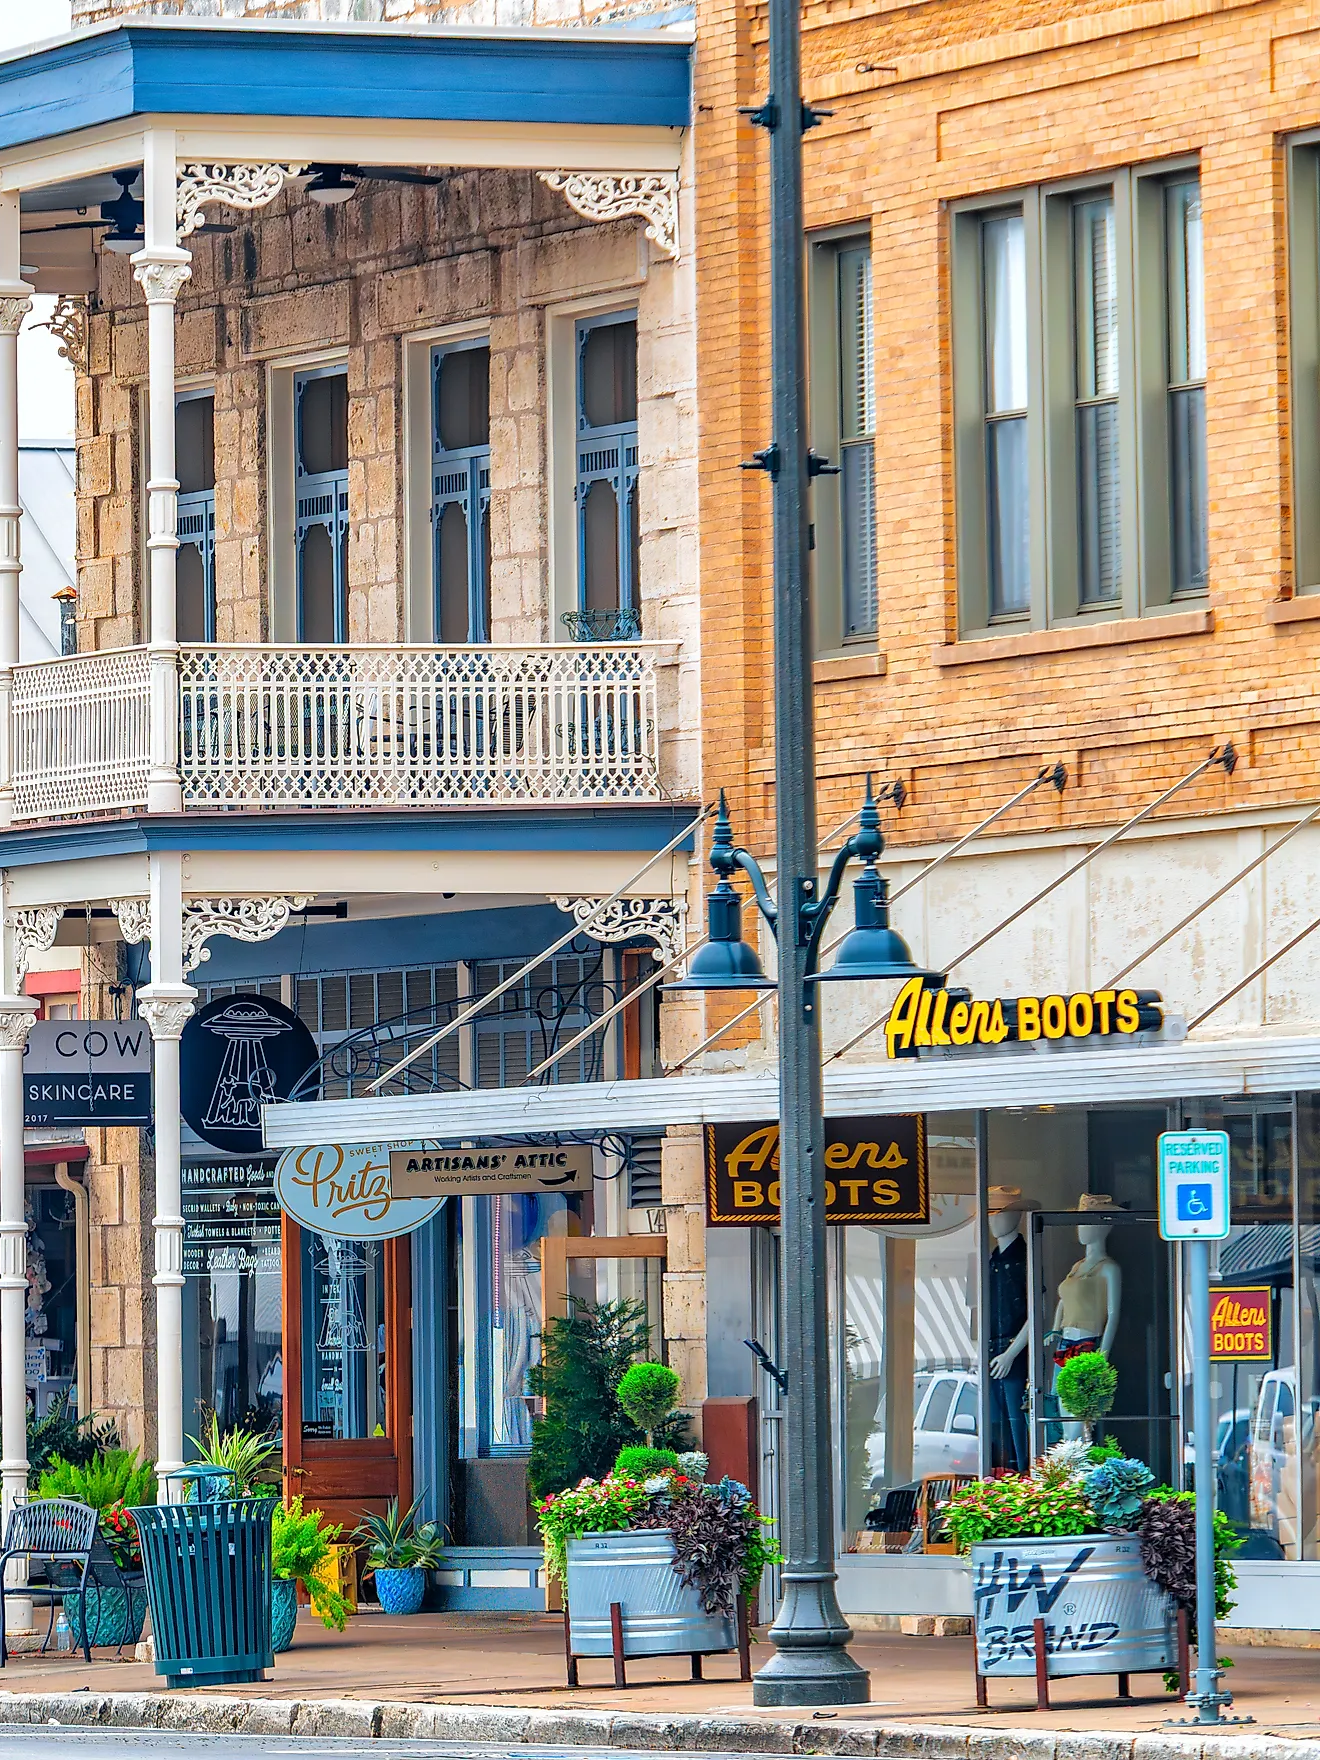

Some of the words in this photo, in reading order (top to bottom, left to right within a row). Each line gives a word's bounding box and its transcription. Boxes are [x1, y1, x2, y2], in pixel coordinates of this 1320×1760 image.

[884, 976, 1009, 1059] Allens
[1017, 989, 1141, 1041] BOOTS
[55, 1030, 143, 1057] COW
[29, 1083, 135, 1101] SKINCARE
[24, 1114, 48, 1123] 2017
[349, 1143, 383, 1158] SWEET
[386, 1139, 414, 1153] SHOP
[723, 1124, 909, 1178] Aens
[1165, 1142, 1223, 1156] RESERVED
[406, 1154, 508, 1173] ARTISANS'
[514, 1152, 568, 1169] ATTIC
[1169, 1160, 1220, 1174] PARKING
[181, 1166, 245, 1184] HANDCRAFTED
[291, 1144, 391, 1221] Pritz
[434, 1174, 461, 1184] Working
[462, 1173, 481, 1182] Artists
[482, 1173, 497, 1181] and
[497, 1172, 532, 1181] Craftsmen
[199, 1203, 221, 1213] WALLETS
[242, 1202, 269, 1212] NON-TOXIC
[205, 1227, 225, 1238] TOWELS
[231, 1226, 256, 1237] BLANKETS
[264, 1224, 281, 1235] POTTE
[183, 1261, 200, 1271] DECOR
[206, 1246, 237, 1270] Leather
[1211, 1295, 1267, 1332] Allens
[1213, 1332, 1265, 1352] BOOTS
